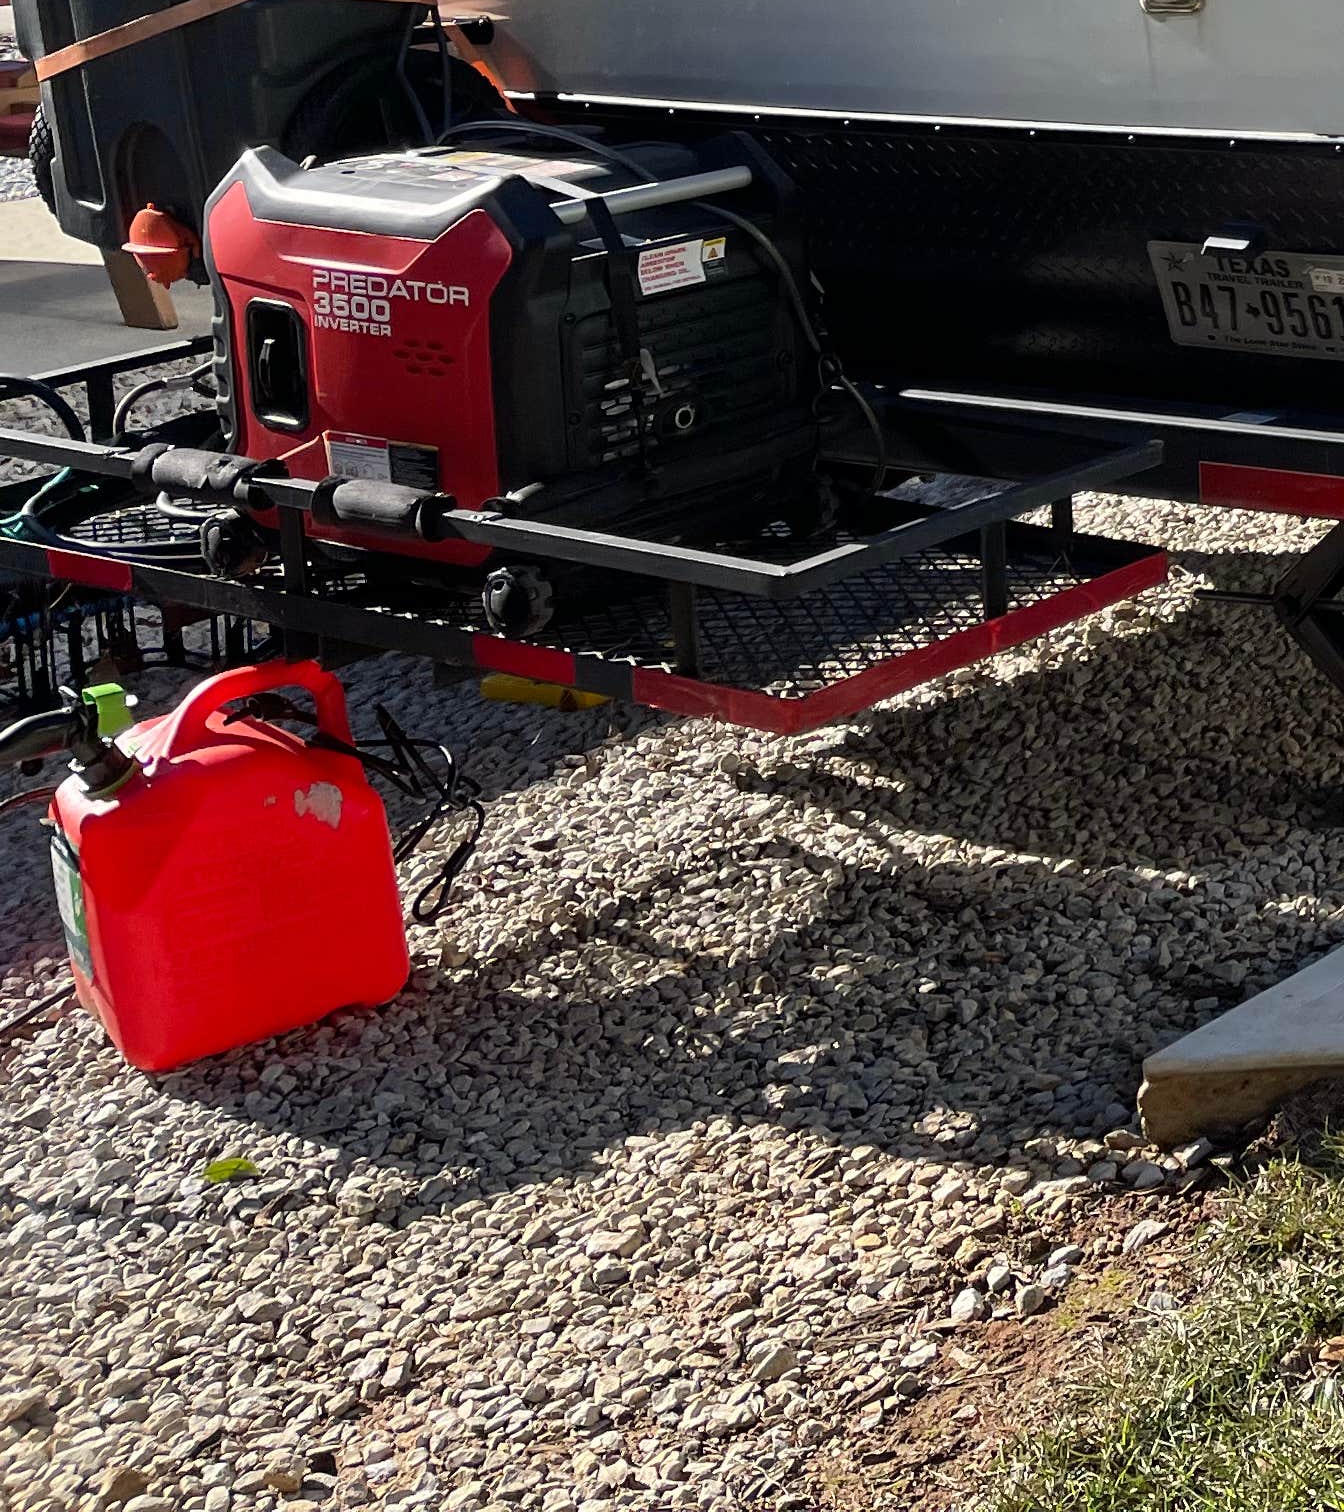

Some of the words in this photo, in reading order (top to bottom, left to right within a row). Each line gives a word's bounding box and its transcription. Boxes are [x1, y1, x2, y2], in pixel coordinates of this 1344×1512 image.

[1215, 254, 1290, 278] TEXAS
[312, 269, 469, 307] PREDATOR
[1206, 272, 1252, 285] TRAVEL
[1254, 276, 1304, 290] TRAILER
[313, 291, 390, 322] 3500
[314, 315, 392, 337] INVERTER
